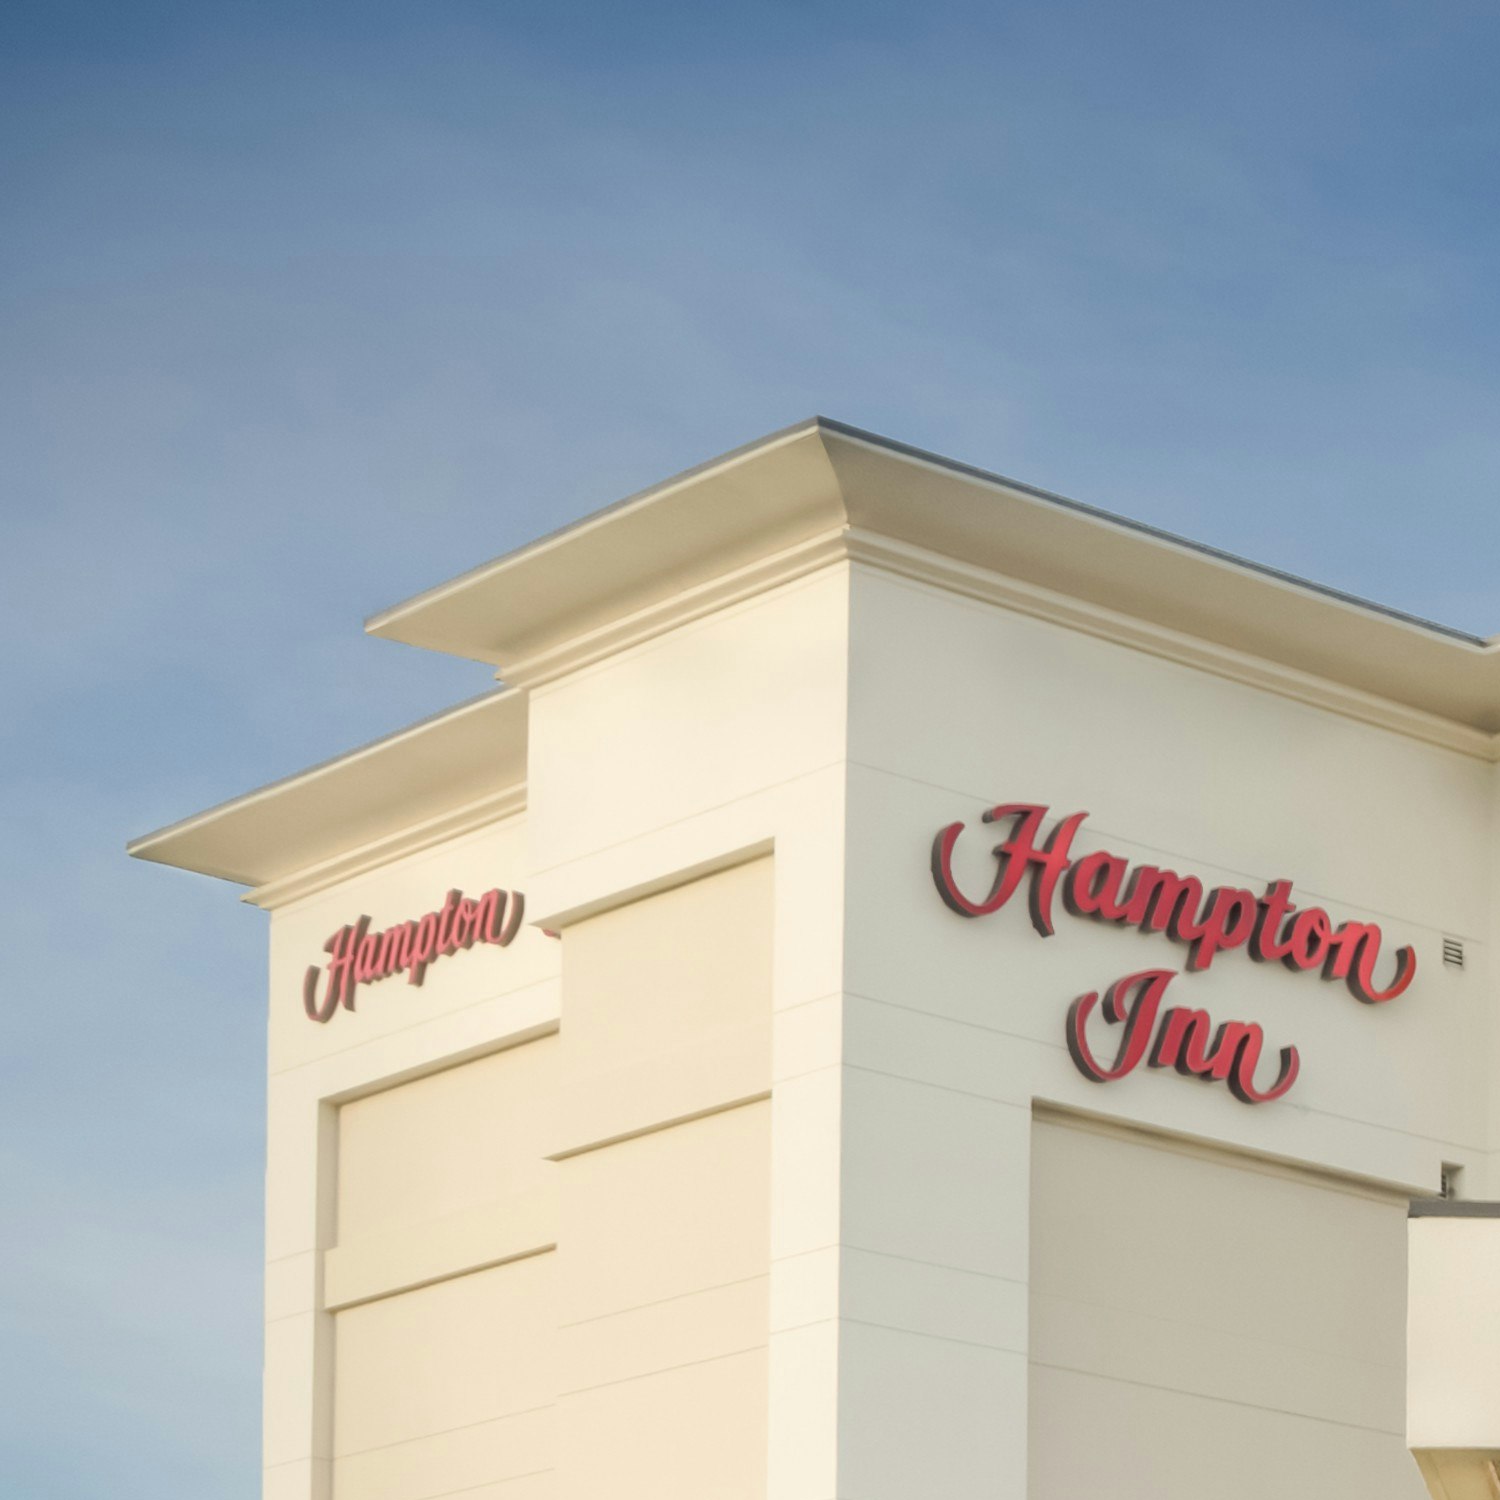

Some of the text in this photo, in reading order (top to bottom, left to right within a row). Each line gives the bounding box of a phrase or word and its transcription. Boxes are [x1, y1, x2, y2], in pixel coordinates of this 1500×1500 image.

[303, 888, 525, 1023] Hampton
[931, 802, 1416, 1004] Hampton
[1066, 969, 1300, 1104] Inn
